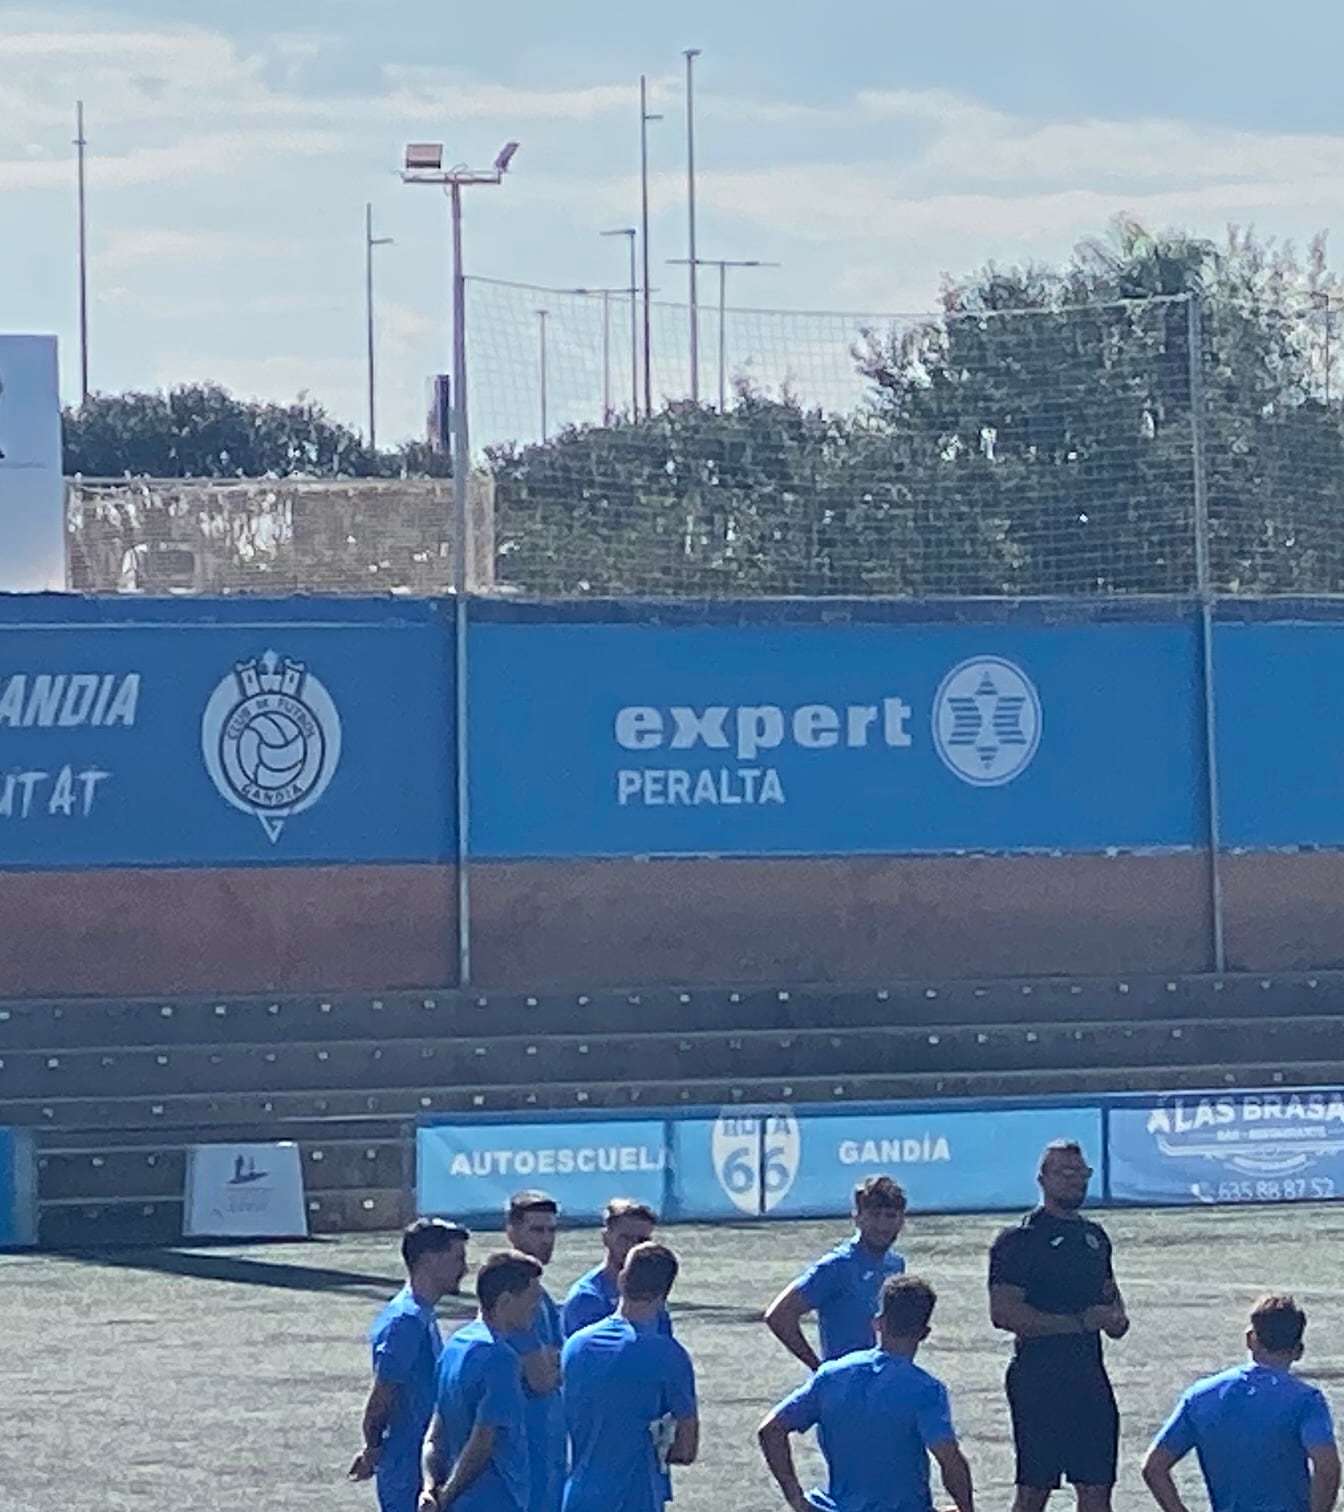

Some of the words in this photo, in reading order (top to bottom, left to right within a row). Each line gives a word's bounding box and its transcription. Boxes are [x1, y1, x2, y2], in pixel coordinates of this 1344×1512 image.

[614, 697, 912, 760] expert
[618, 768, 785, 805] PERALTA
[722, 1112, 791, 1136] RUA
[723, 1146, 790, 1194] 66
[1283, 1179, 1306, 1200] 87
